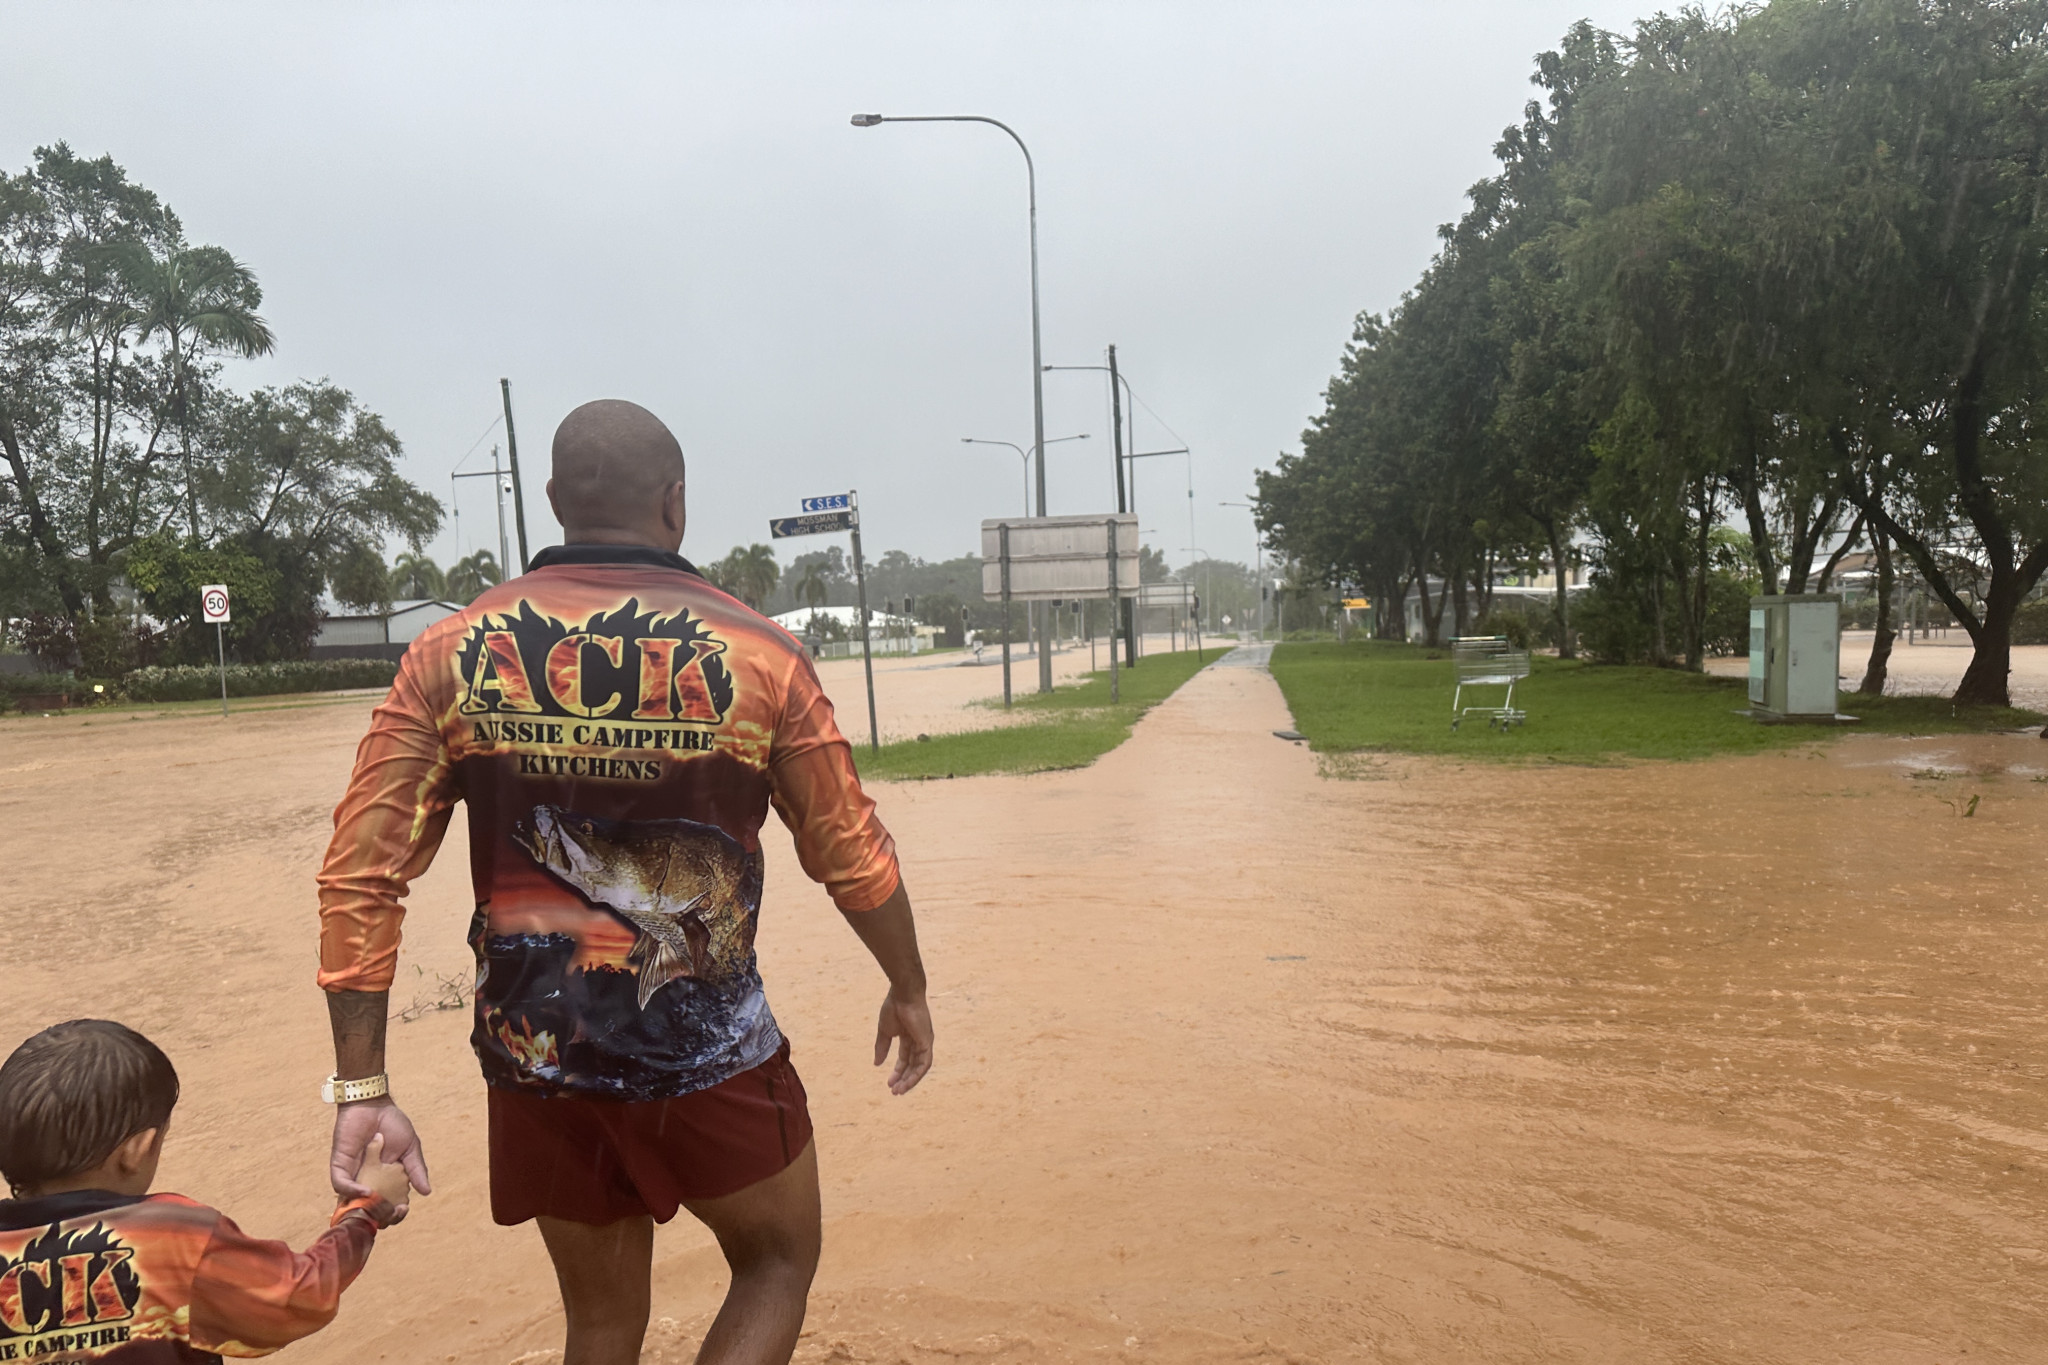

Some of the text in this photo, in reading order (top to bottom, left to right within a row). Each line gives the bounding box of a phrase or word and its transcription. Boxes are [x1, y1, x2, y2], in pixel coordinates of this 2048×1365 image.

[816, 496, 845, 510] S.E.S.
[790, 521, 844, 536] HIGH SCHOO
[796, 513, 839, 526] MOSSMAN
[208, 597, 225, 610] 50
[459, 629, 728, 725] ACK
[472, 719, 716, 752] AUSSIE CAMPFIRE
[519, 754, 662, 781] KITCHENS
[24, 1326, 131, 1357] CAMPFIRE
